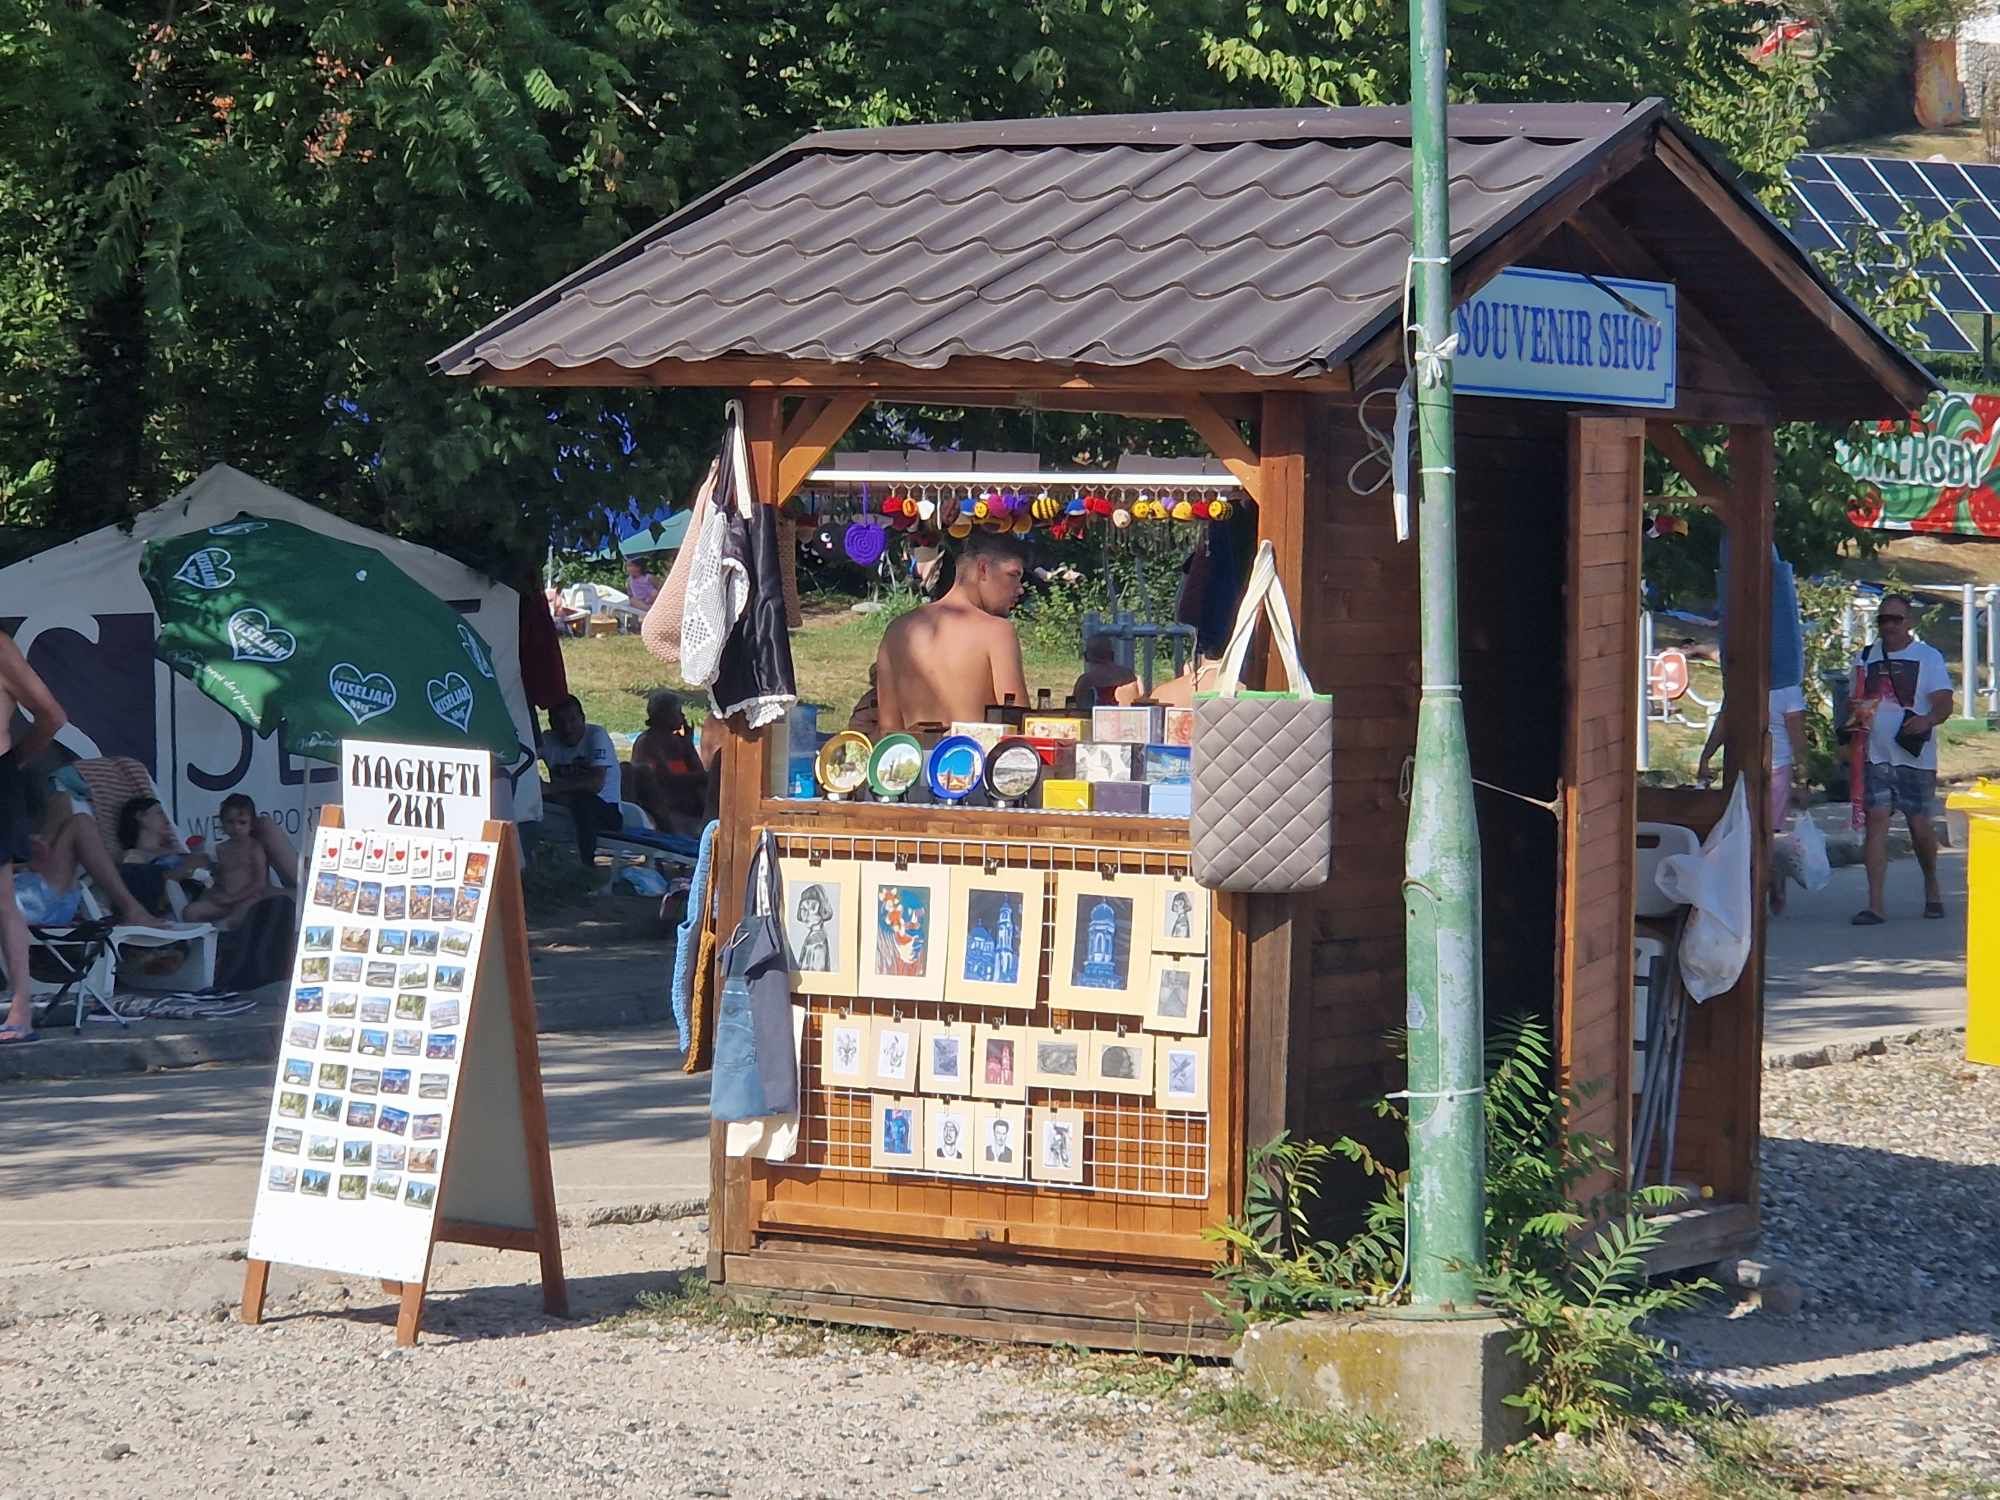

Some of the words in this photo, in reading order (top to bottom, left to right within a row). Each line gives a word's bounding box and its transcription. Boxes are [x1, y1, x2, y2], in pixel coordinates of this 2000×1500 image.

[1456, 299, 1593, 367] SOUVENIR
[1599, 312, 1662, 371] SHOP
[231, 618, 289, 660] KISELJAK
[332, 679, 392, 706] KISELJAK
[434, 686, 472, 713] KISELJAK
[351, 753, 482, 797] MAGNETI
[386, 793, 445, 830] 2KM
